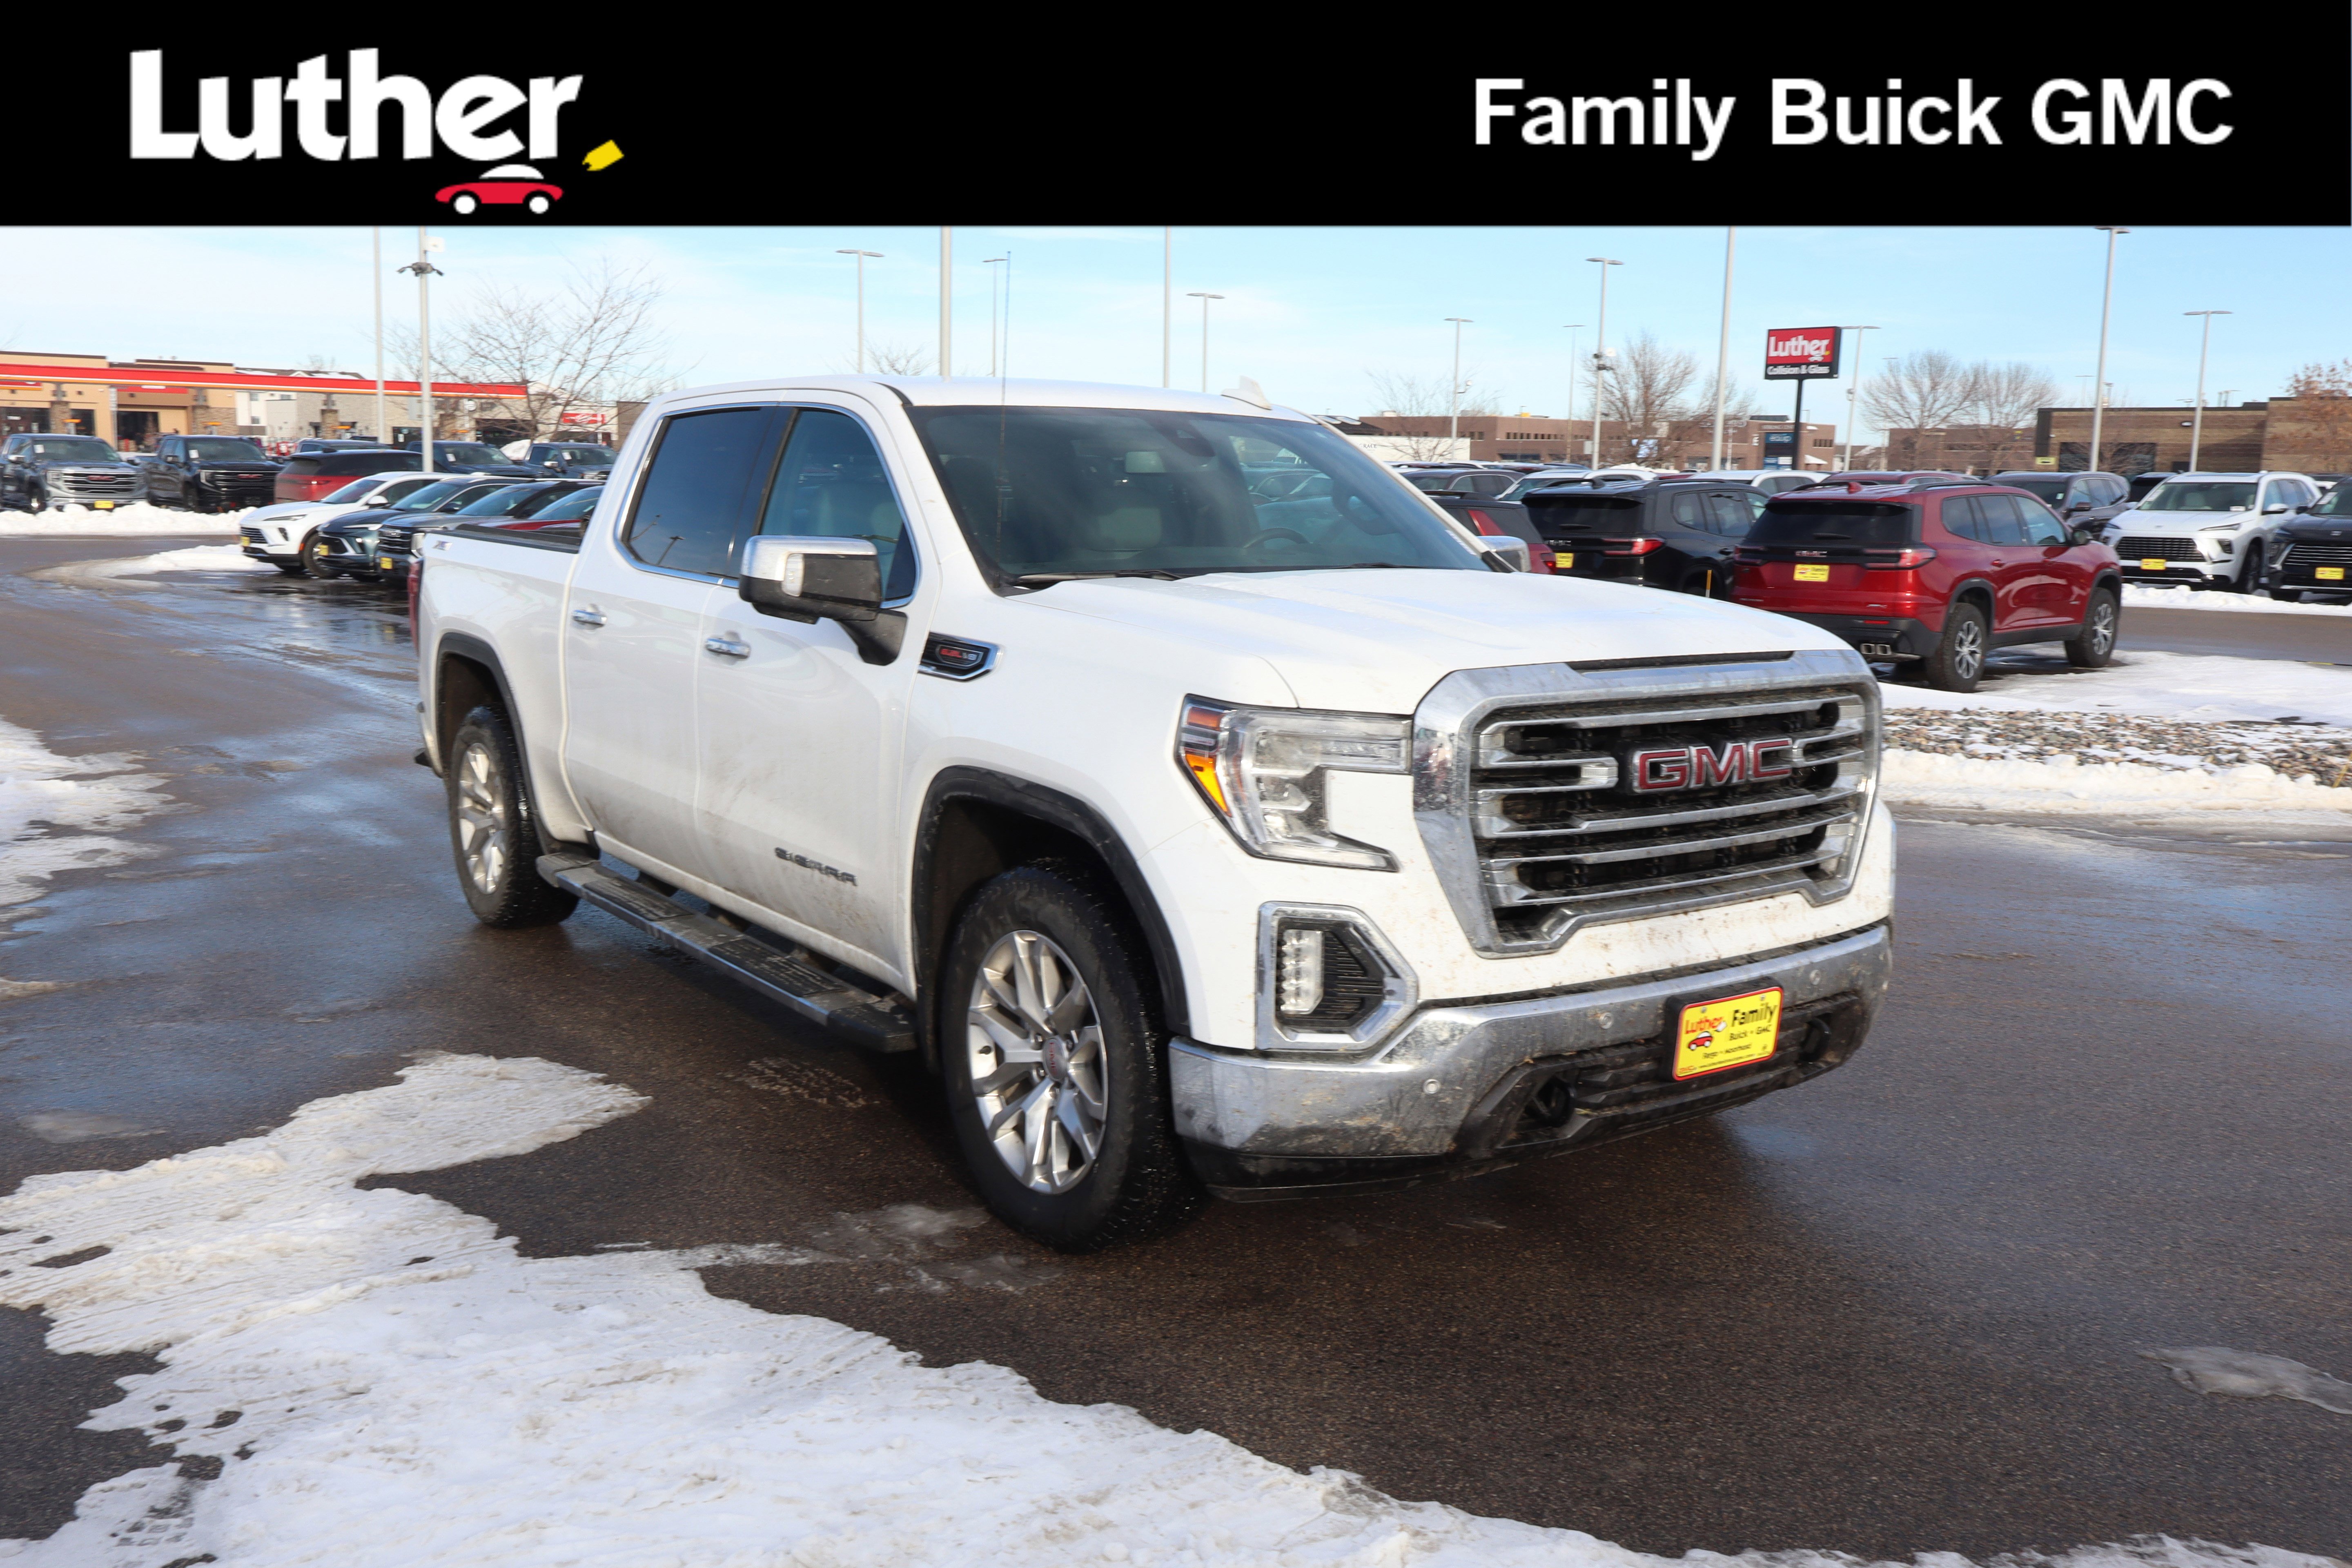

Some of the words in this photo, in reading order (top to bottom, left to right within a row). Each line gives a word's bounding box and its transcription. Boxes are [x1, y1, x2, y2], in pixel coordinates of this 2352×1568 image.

[1768, 335, 1830, 356] Luther
[1633, 738, 1793, 793] GMC
[775, 847, 858, 886] SIERRA
[1685, 1016, 1723, 1034] Luther
[1731, 1002, 1778, 1027] Family
[1729, 1031, 1748, 1041] Buick
